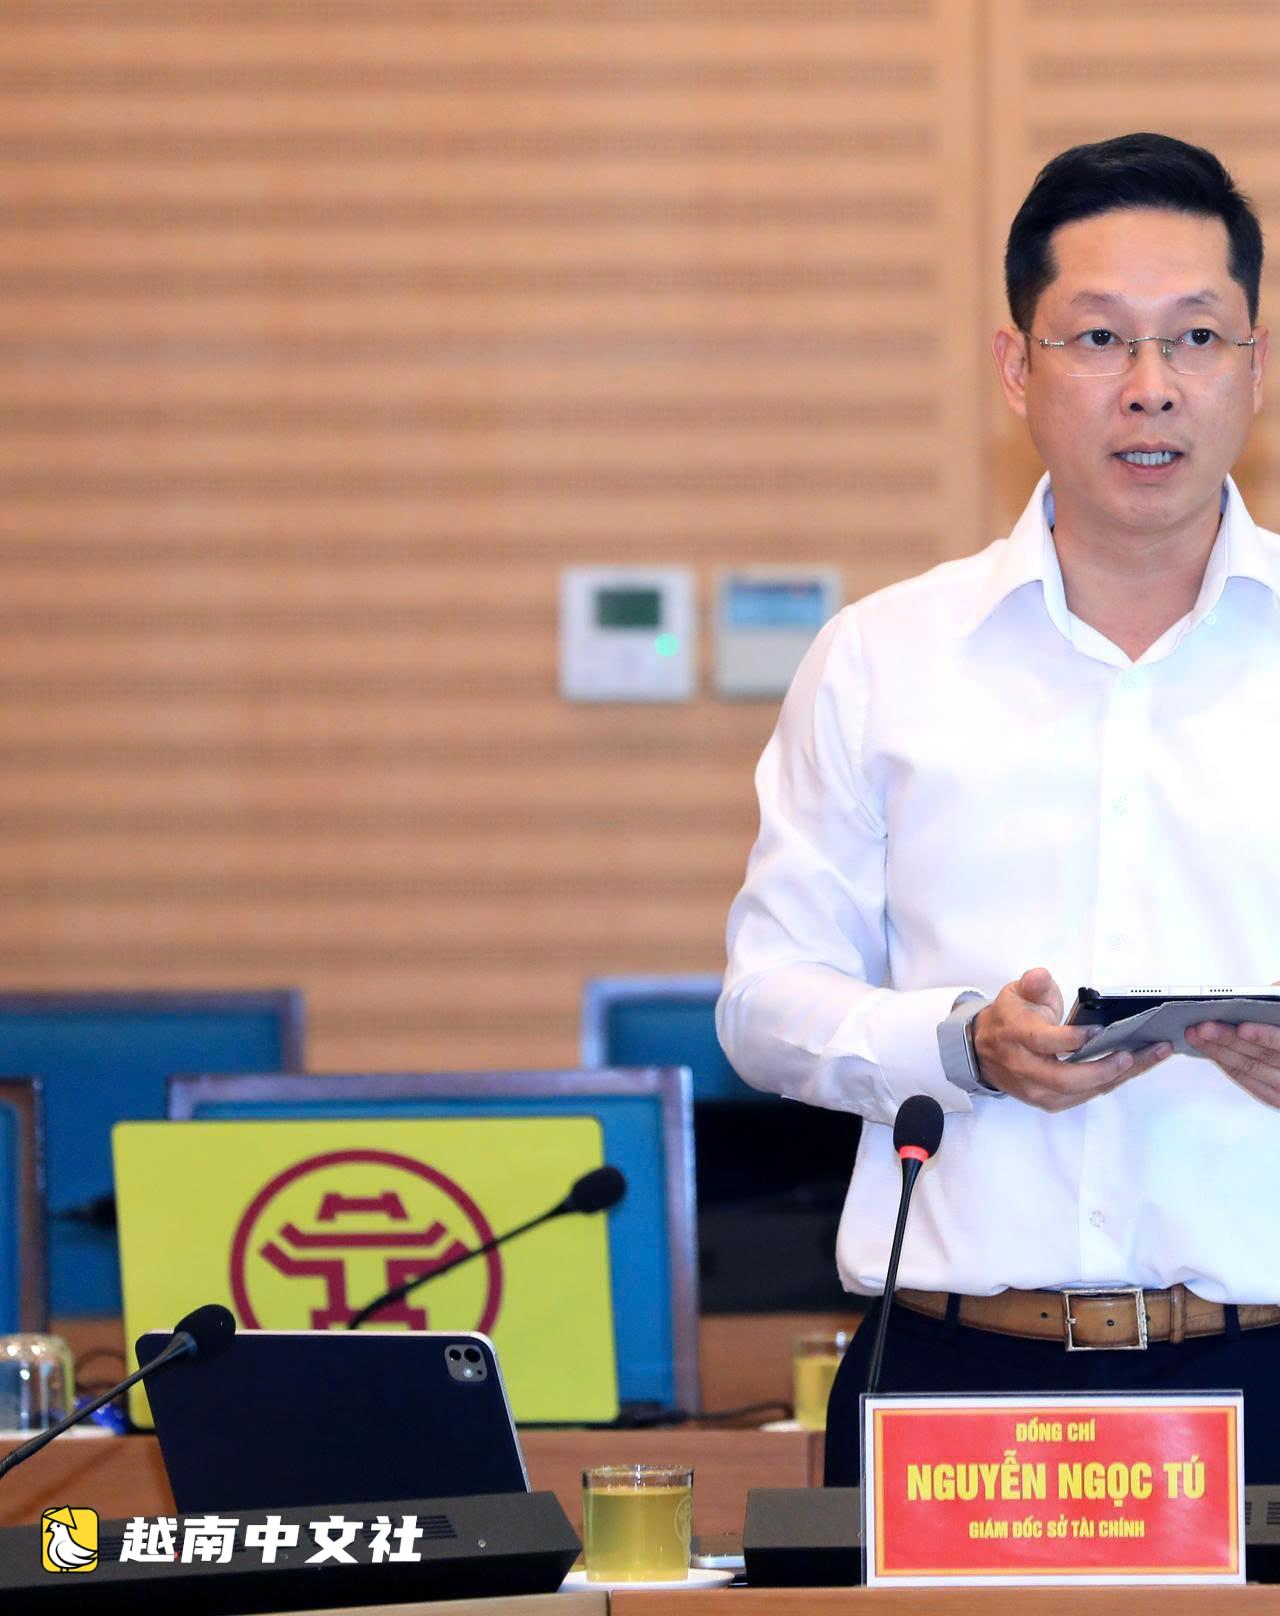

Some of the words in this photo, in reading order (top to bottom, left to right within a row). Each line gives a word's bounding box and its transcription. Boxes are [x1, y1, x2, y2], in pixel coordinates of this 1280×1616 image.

[1067, 1418, 1096, 1442] CHÍ
[907, 1449, 1046, 1501] NGUYỄN
[1058, 1462, 1152, 1507] NGỌC
[1163, 1456, 1205, 1499] TÚ
[969, 1517, 1008, 1539] GIÁM
[1012, 1515, 1043, 1539] ĐỐC
[1047, 1513, 1068, 1538] SỞ
[1071, 1517, 1094, 1538] TÀI
[1099, 1517, 1145, 1538] CHÍNH
